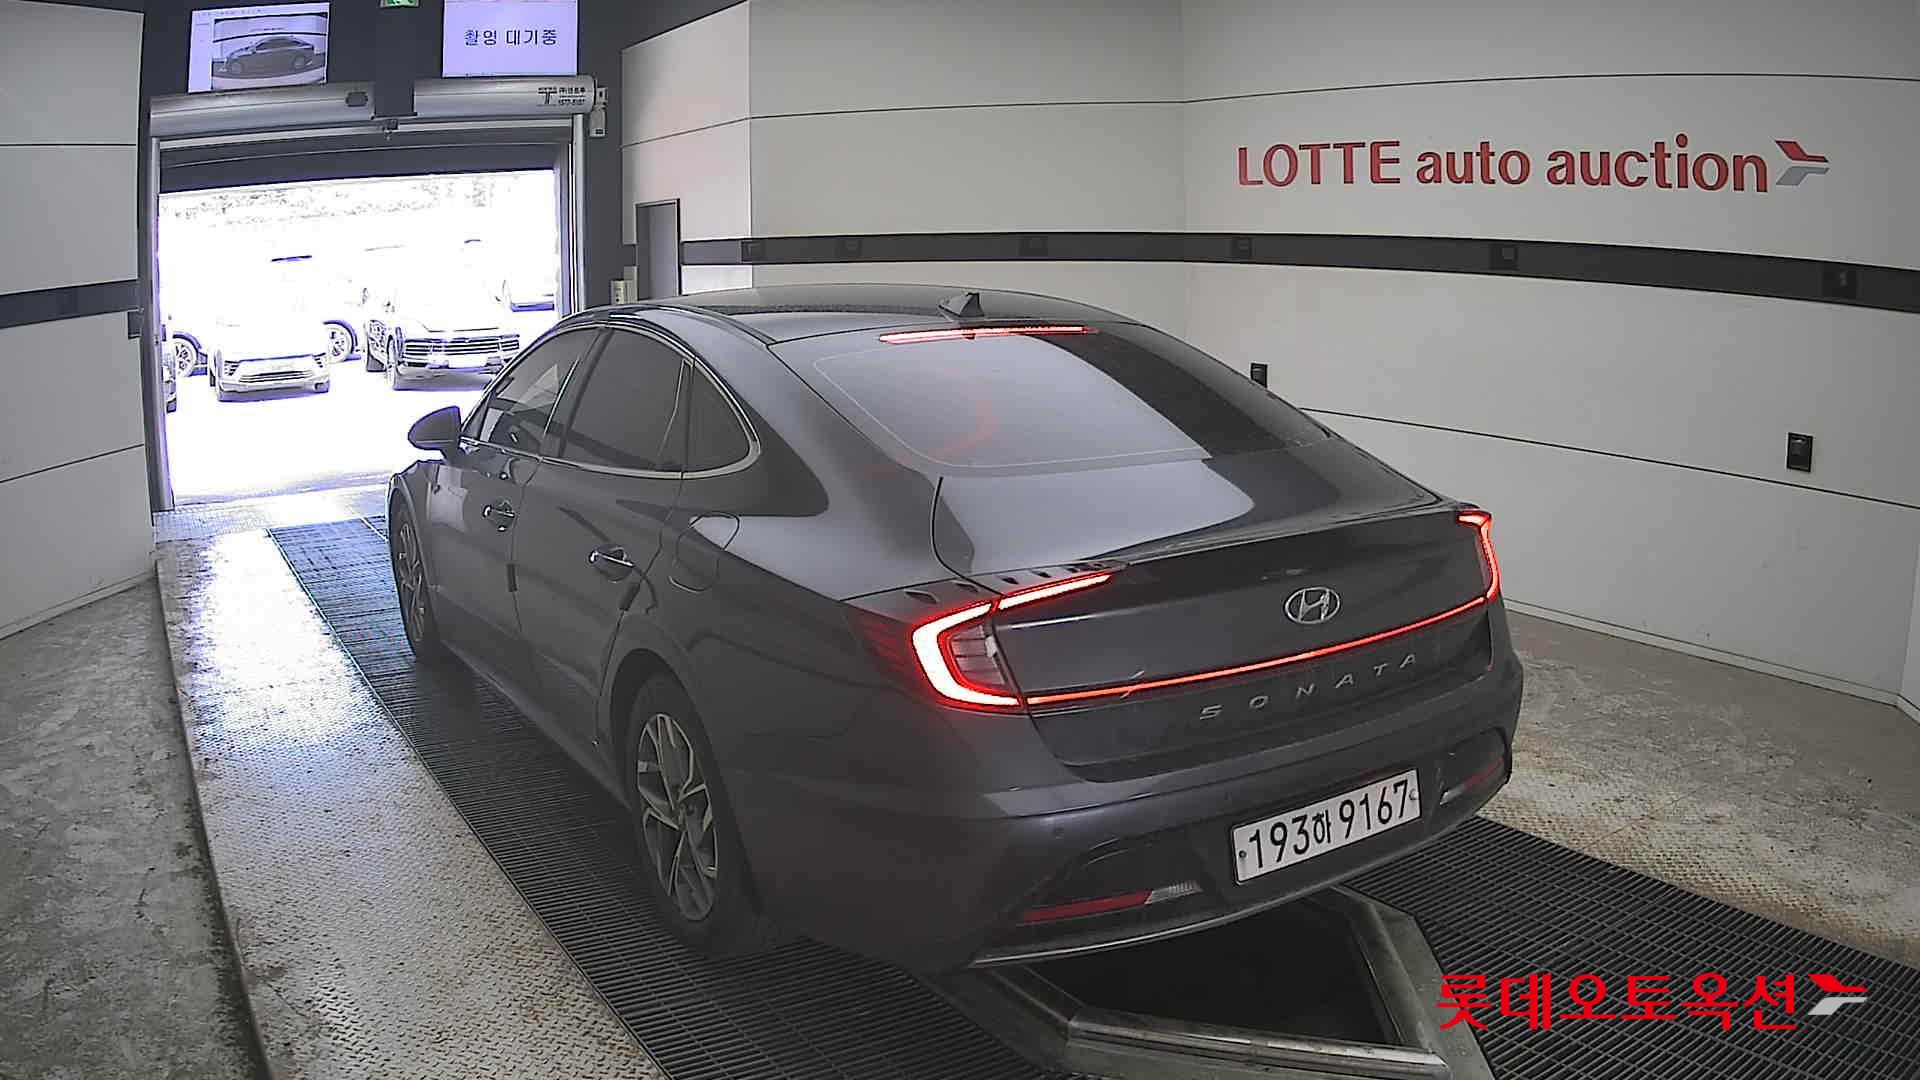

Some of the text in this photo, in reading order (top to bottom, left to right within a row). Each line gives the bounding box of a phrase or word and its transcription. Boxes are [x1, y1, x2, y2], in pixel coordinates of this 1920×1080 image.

[505, 29, 558, 46] 대기중
[1238, 133, 1769, 193] LOTTE auto auction
[1199, 653, 1417, 721] SONATA
